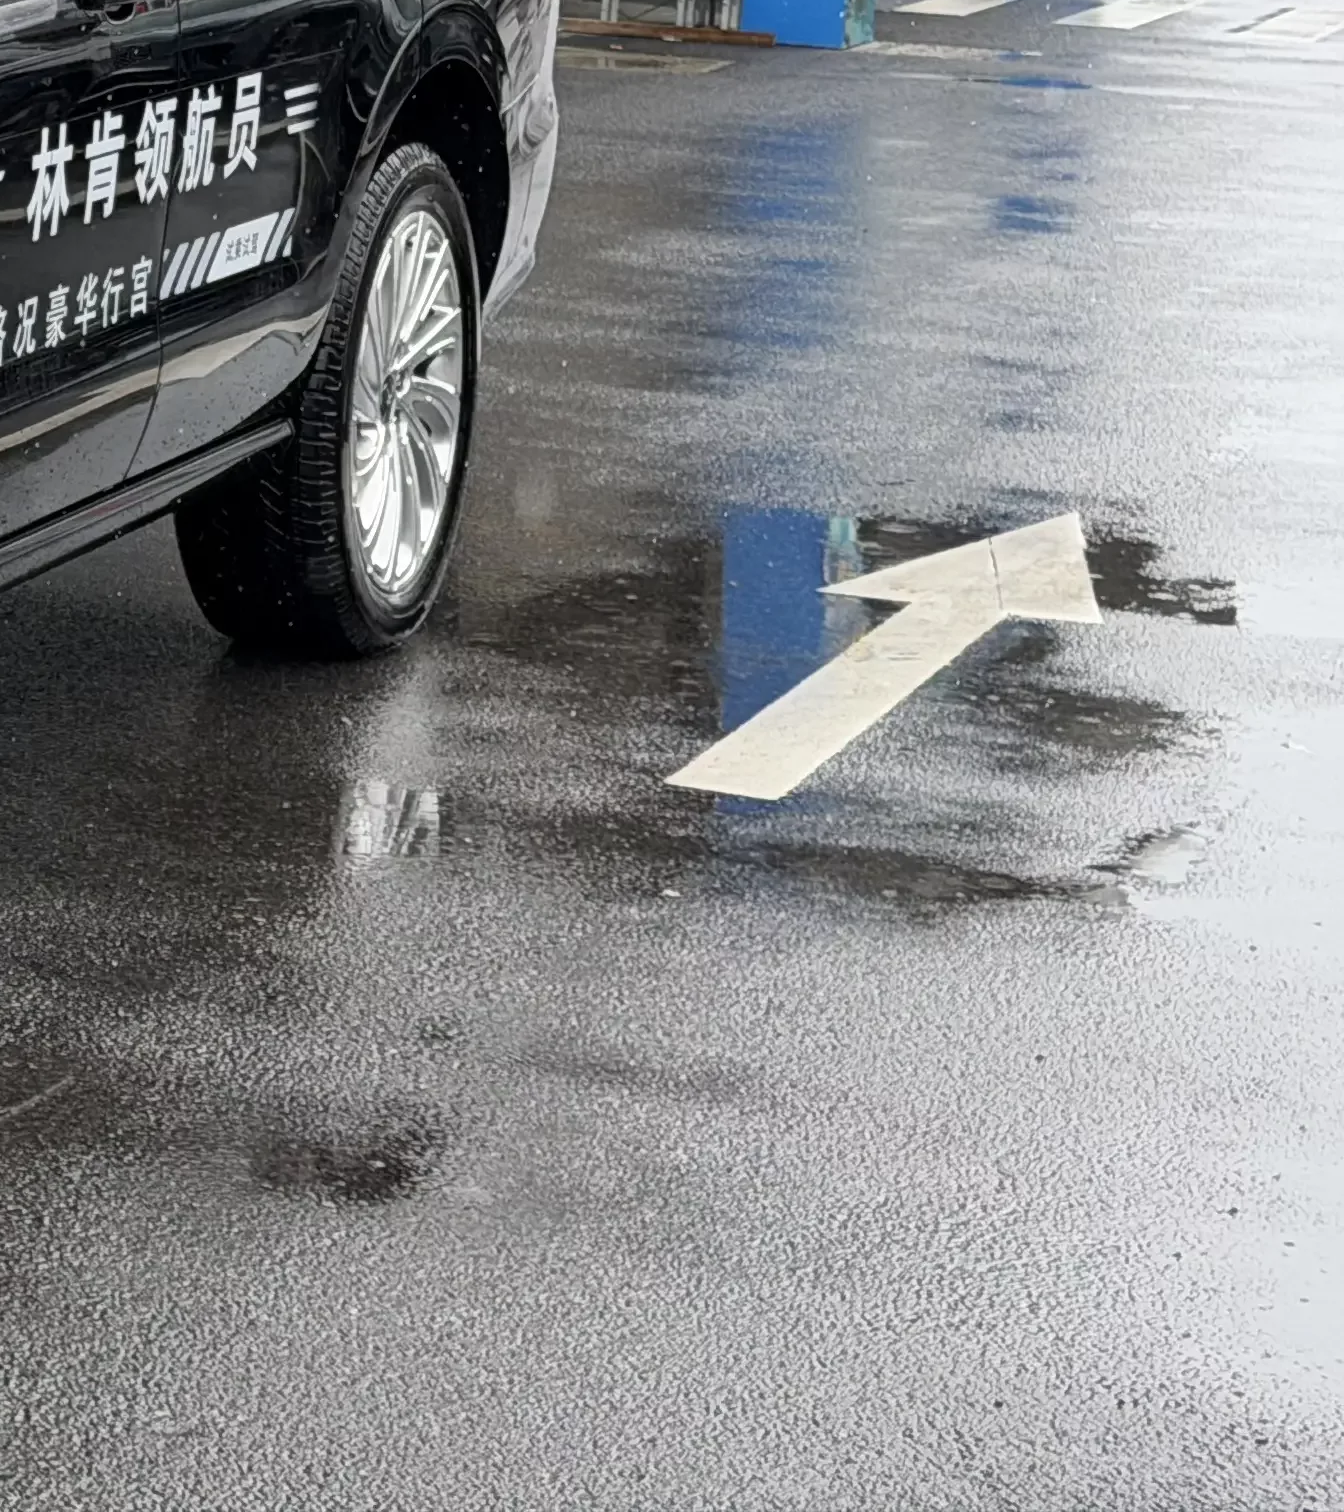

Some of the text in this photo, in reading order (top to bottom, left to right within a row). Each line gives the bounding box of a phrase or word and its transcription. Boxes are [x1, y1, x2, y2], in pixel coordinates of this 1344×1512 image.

[27, 72, 263, 242] 林肯领航员
